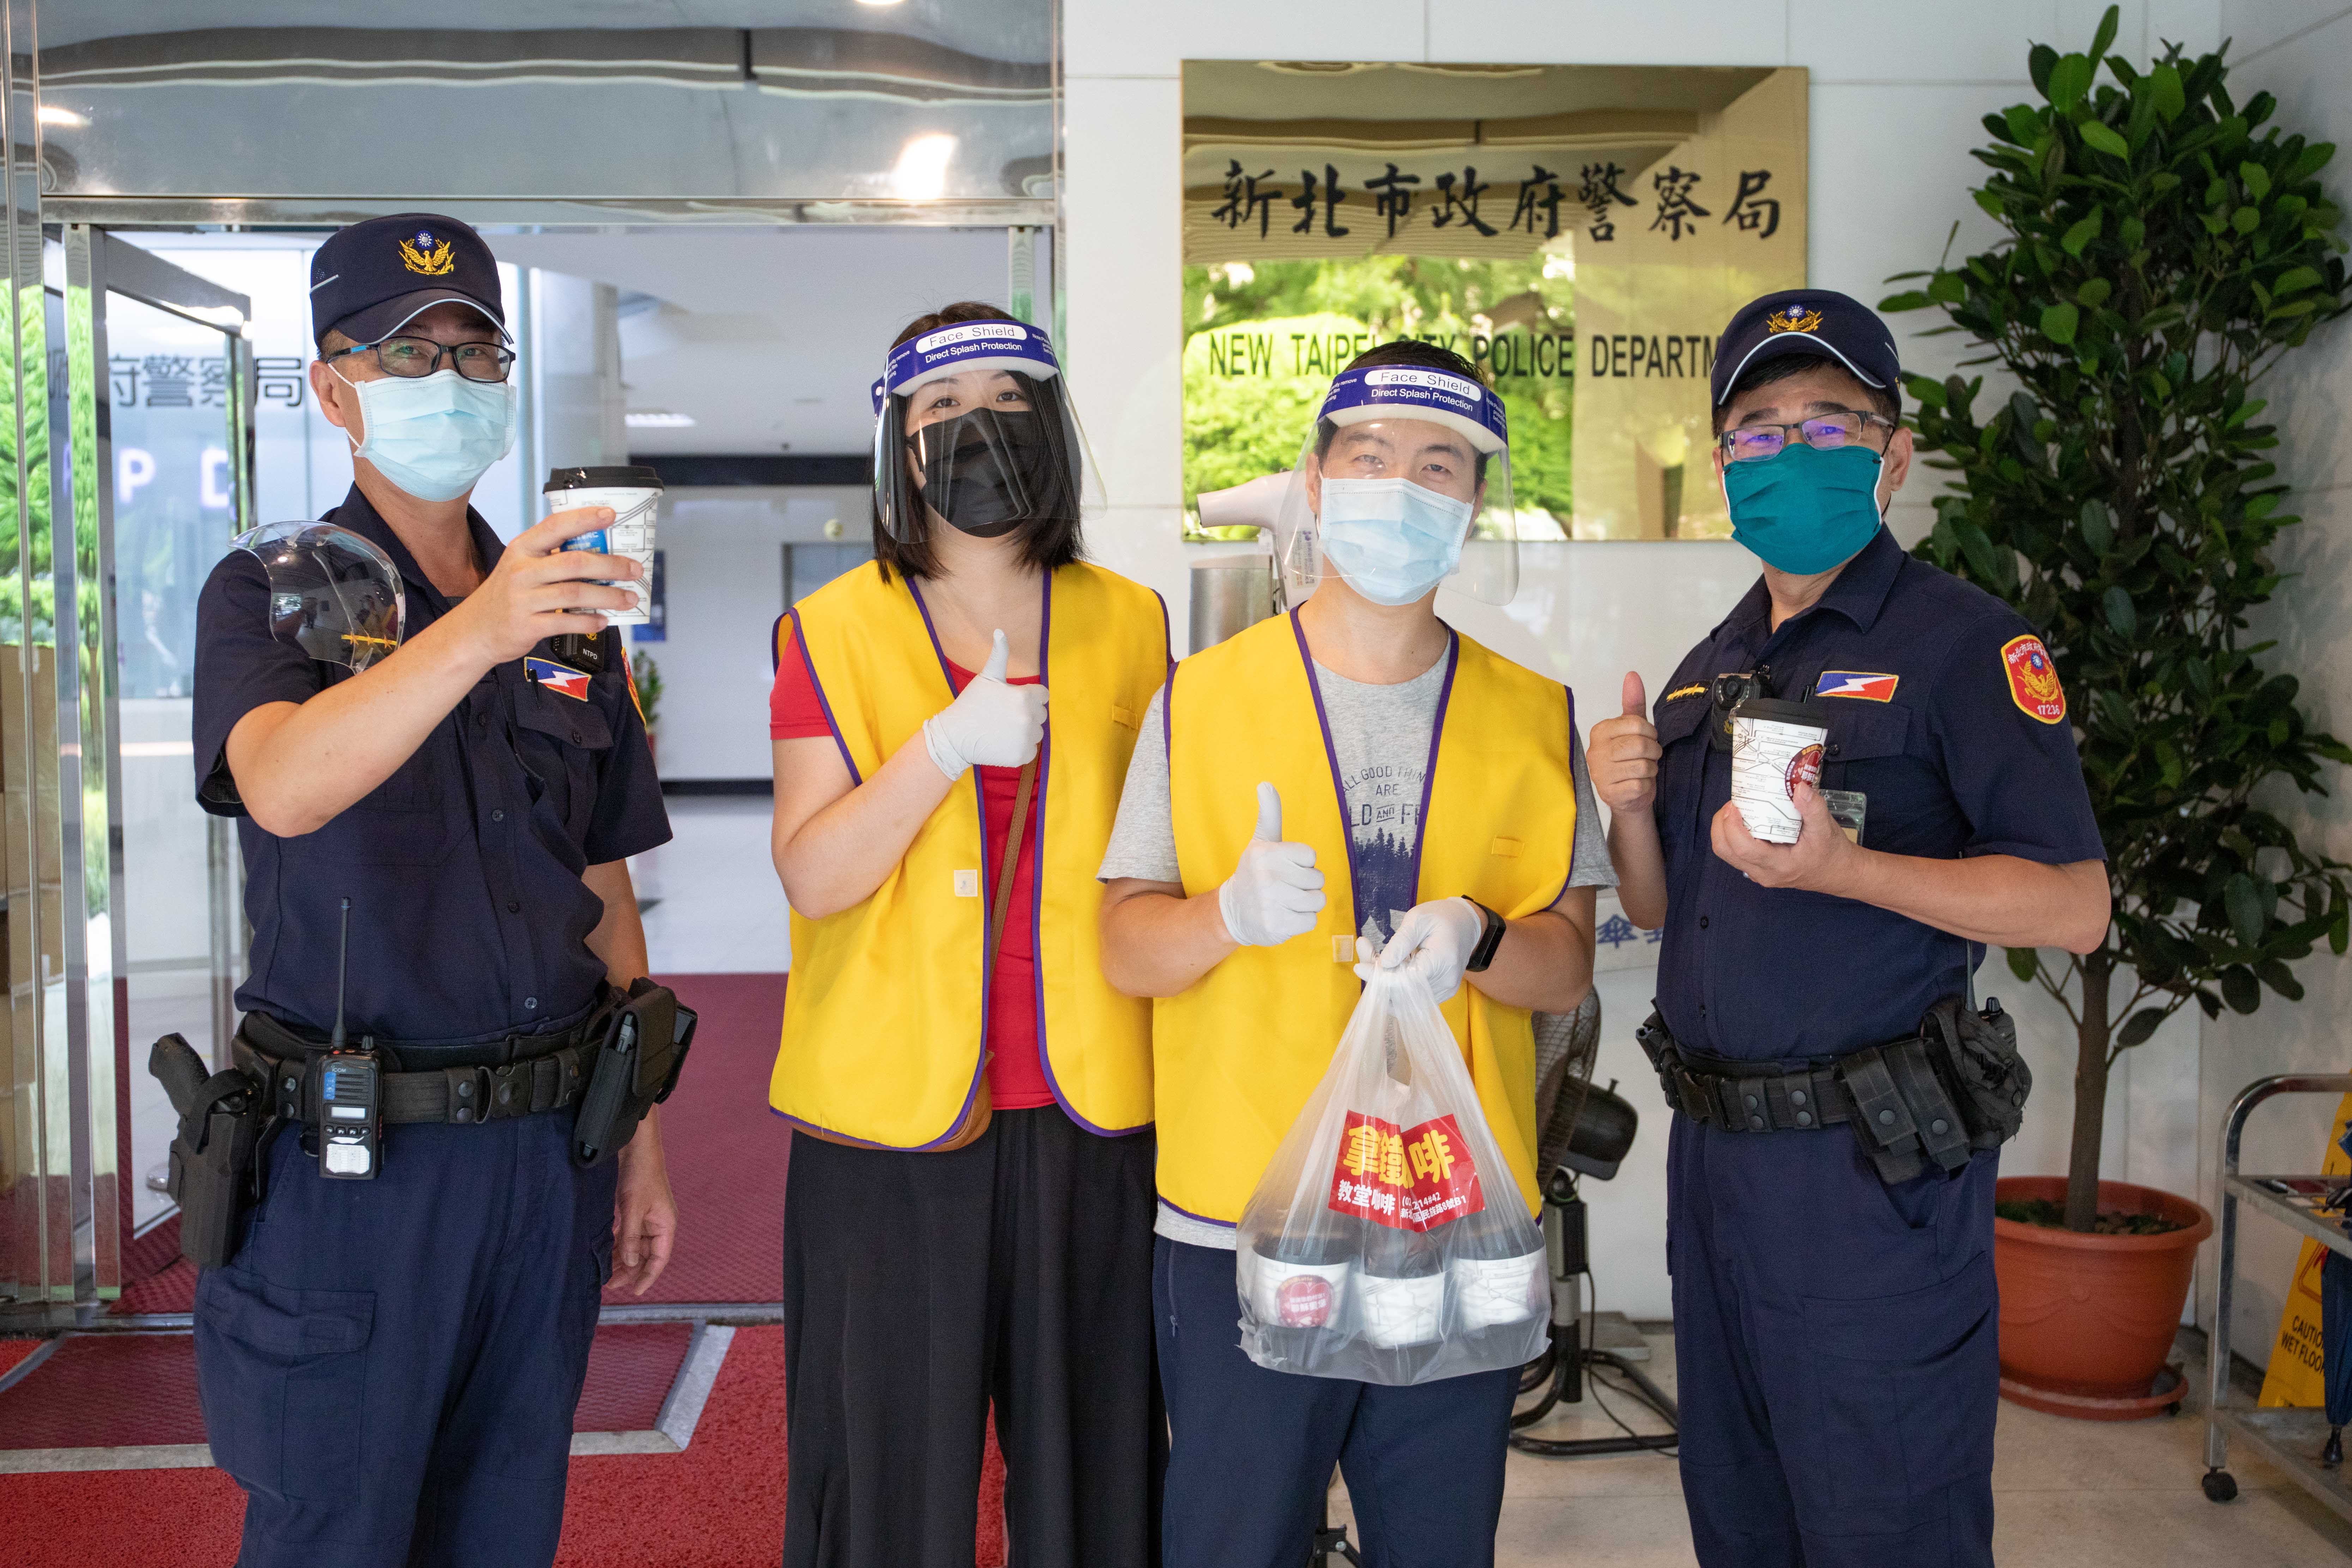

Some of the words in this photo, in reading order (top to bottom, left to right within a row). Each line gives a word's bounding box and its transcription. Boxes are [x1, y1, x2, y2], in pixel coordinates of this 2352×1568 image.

[1212, 159, 1781, 242] 新北市政府警察局
[929, 331, 963, 347] Face
[972, 326, 1015, 337] Shield
[896, 350, 910, 361] remove
[925, 350, 949, 363] Direct
[950, 344, 980, 356] Splash
[981, 342, 1022, 351] Protection
[1210, 333, 1272, 375] NEW
[1473, 334, 1574, 378] POLICE
[1381, 372, 1417, 383] Face
[1427, 374, 1471, 395] Shield
[1371, 388, 1397, 398] Direct
[1399, 388, 1430, 401] Splash
[1432, 391, 1473, 412] Protection
[118, 447, 156, 504] P
[583, 648, 597, 660] NTPD
[2037, 704, 2060, 715] 17236
[1343, 775, 1361, 794] ALL
[1361, 766, 1392, 780] GOOD
[1376, 784, 1399, 796] ARE
[1377, 807, 1395, 820] AND
[1343, 1125, 1455, 1189] 拿鐵啡
[1337, 1179, 1396, 1216] 教堂咖啡
[2281, 1331, 2300, 1355] WET
[2292, 1315, 2324, 1350] CAUTIO
